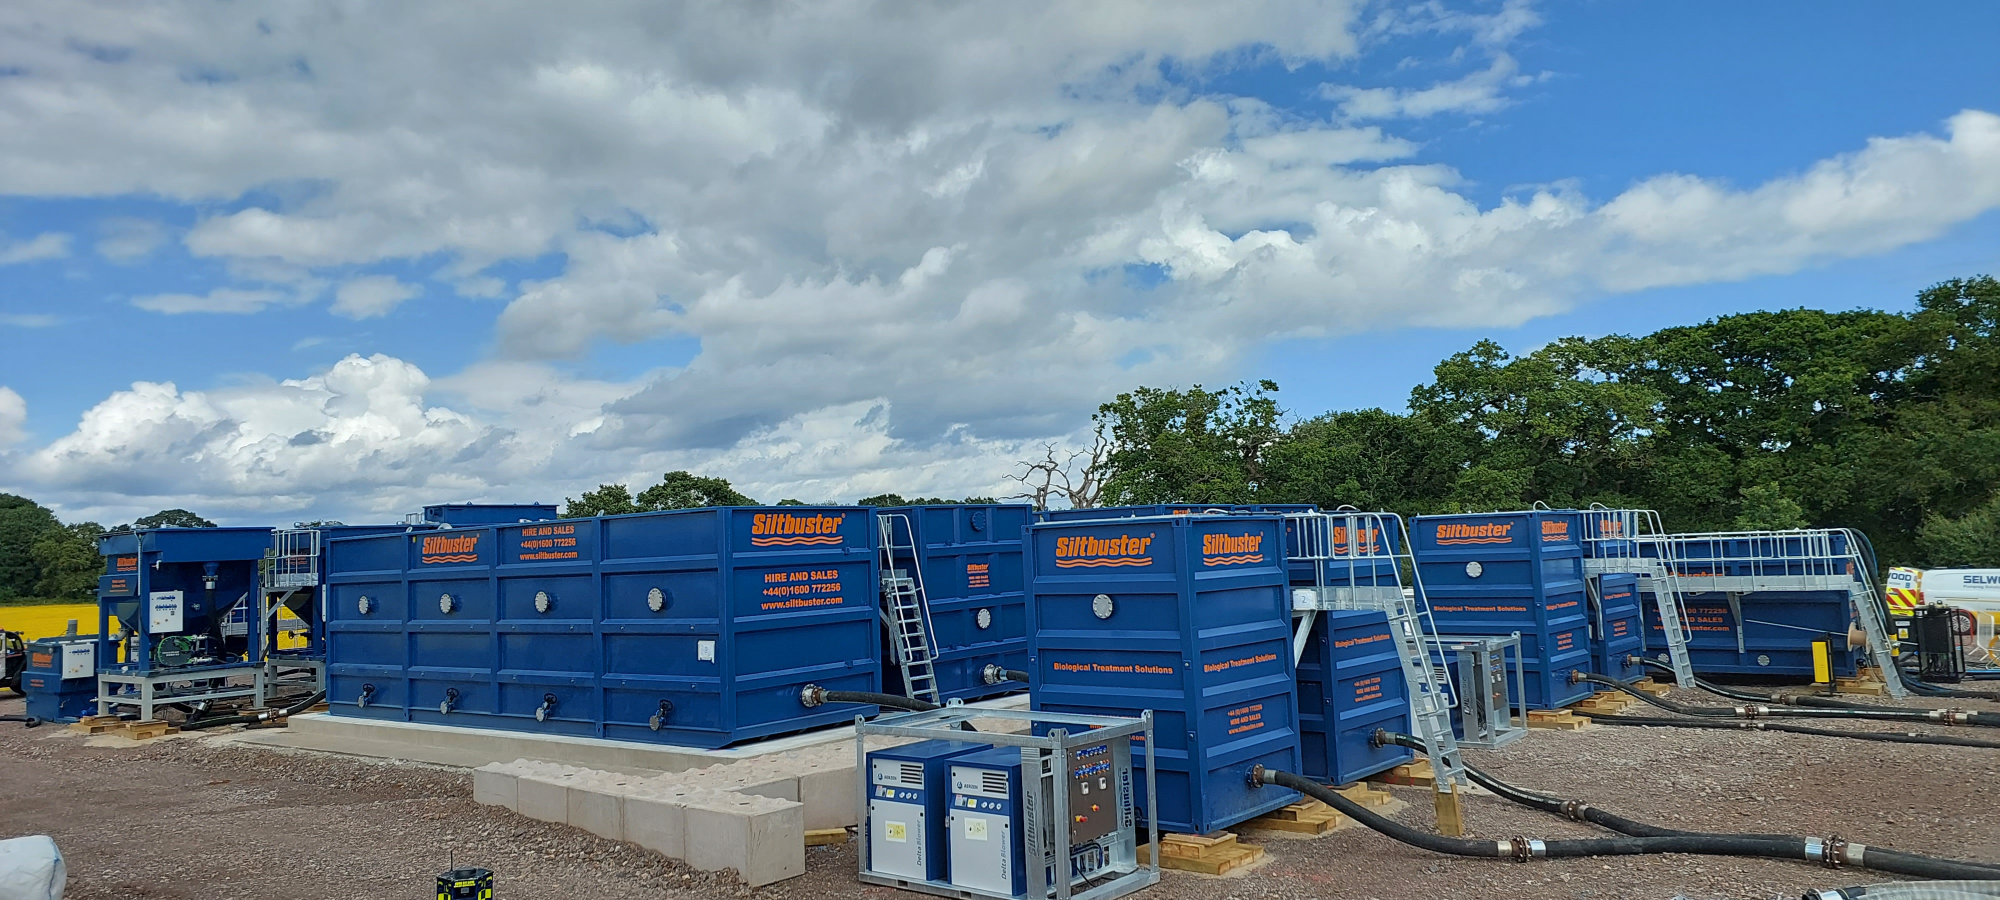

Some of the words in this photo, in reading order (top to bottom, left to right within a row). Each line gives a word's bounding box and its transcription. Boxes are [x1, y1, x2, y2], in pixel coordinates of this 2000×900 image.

[522, 527, 537, 537] HIRE
[539, 526, 552, 536] AND
[554, 525, 574, 535] SALES
[752, 513, 843, 535] Siltbuster
[1436, 522, 1511, 538] Siltbuster
[422, 534, 478, 554] Siltbuster
[554, 538, 576, 547] 772256
[1055, 534, 1151, 557] Siltbuster
[1203, 531, 1262, 555] Siltbuster
[520, 551, 578, 561] www.siltbuster.com
[764, 572, 787, 583] HIRE
[789, 571, 808, 582] AND
[811, 569, 838, 580] SALES
[1963, 575, 2000, 584] SELW
[762, 585, 810, 597] +44(0)1600
[811, 583, 841, 593] 772256
[761, 597, 843, 610] www.siltbuster.com
[1053, 662, 1091, 673] Biological
[1092, 663, 1133, 673] Treatment
[1135, 665, 1173, 675] Solutions
